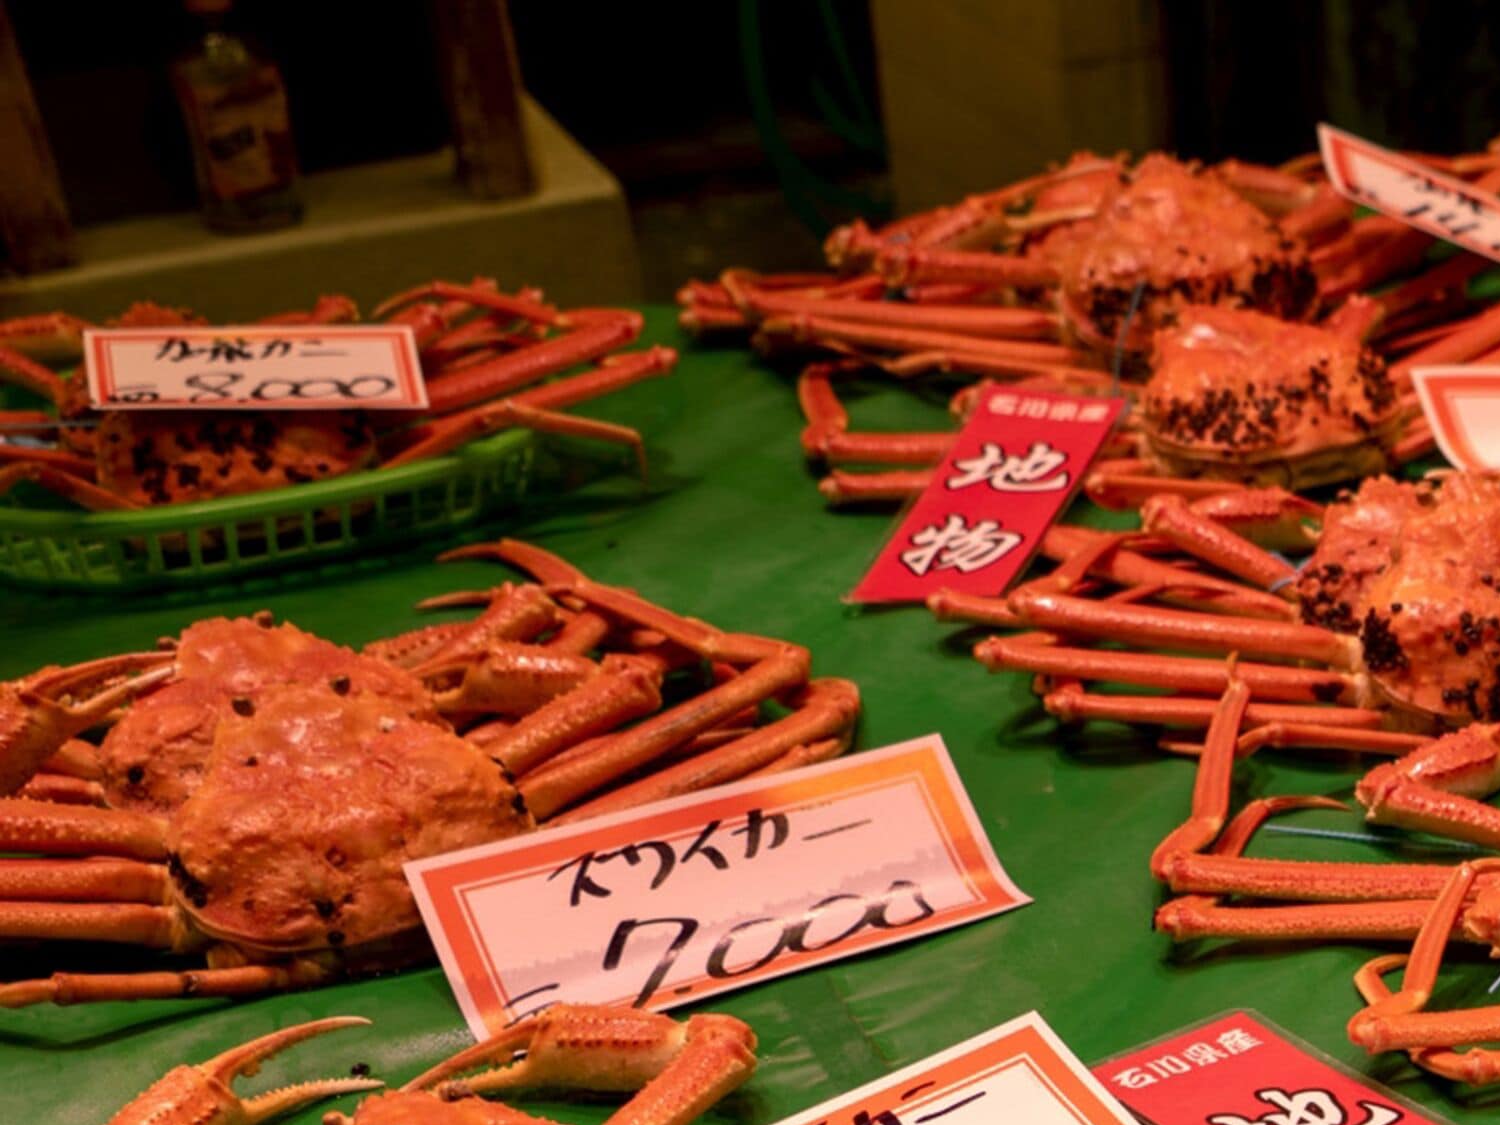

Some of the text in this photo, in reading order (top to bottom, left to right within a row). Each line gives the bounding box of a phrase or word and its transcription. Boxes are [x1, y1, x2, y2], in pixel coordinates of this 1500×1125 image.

[899, 440, 1070, 577] 地物
[1111, 1027, 1265, 1089] 石川県産
